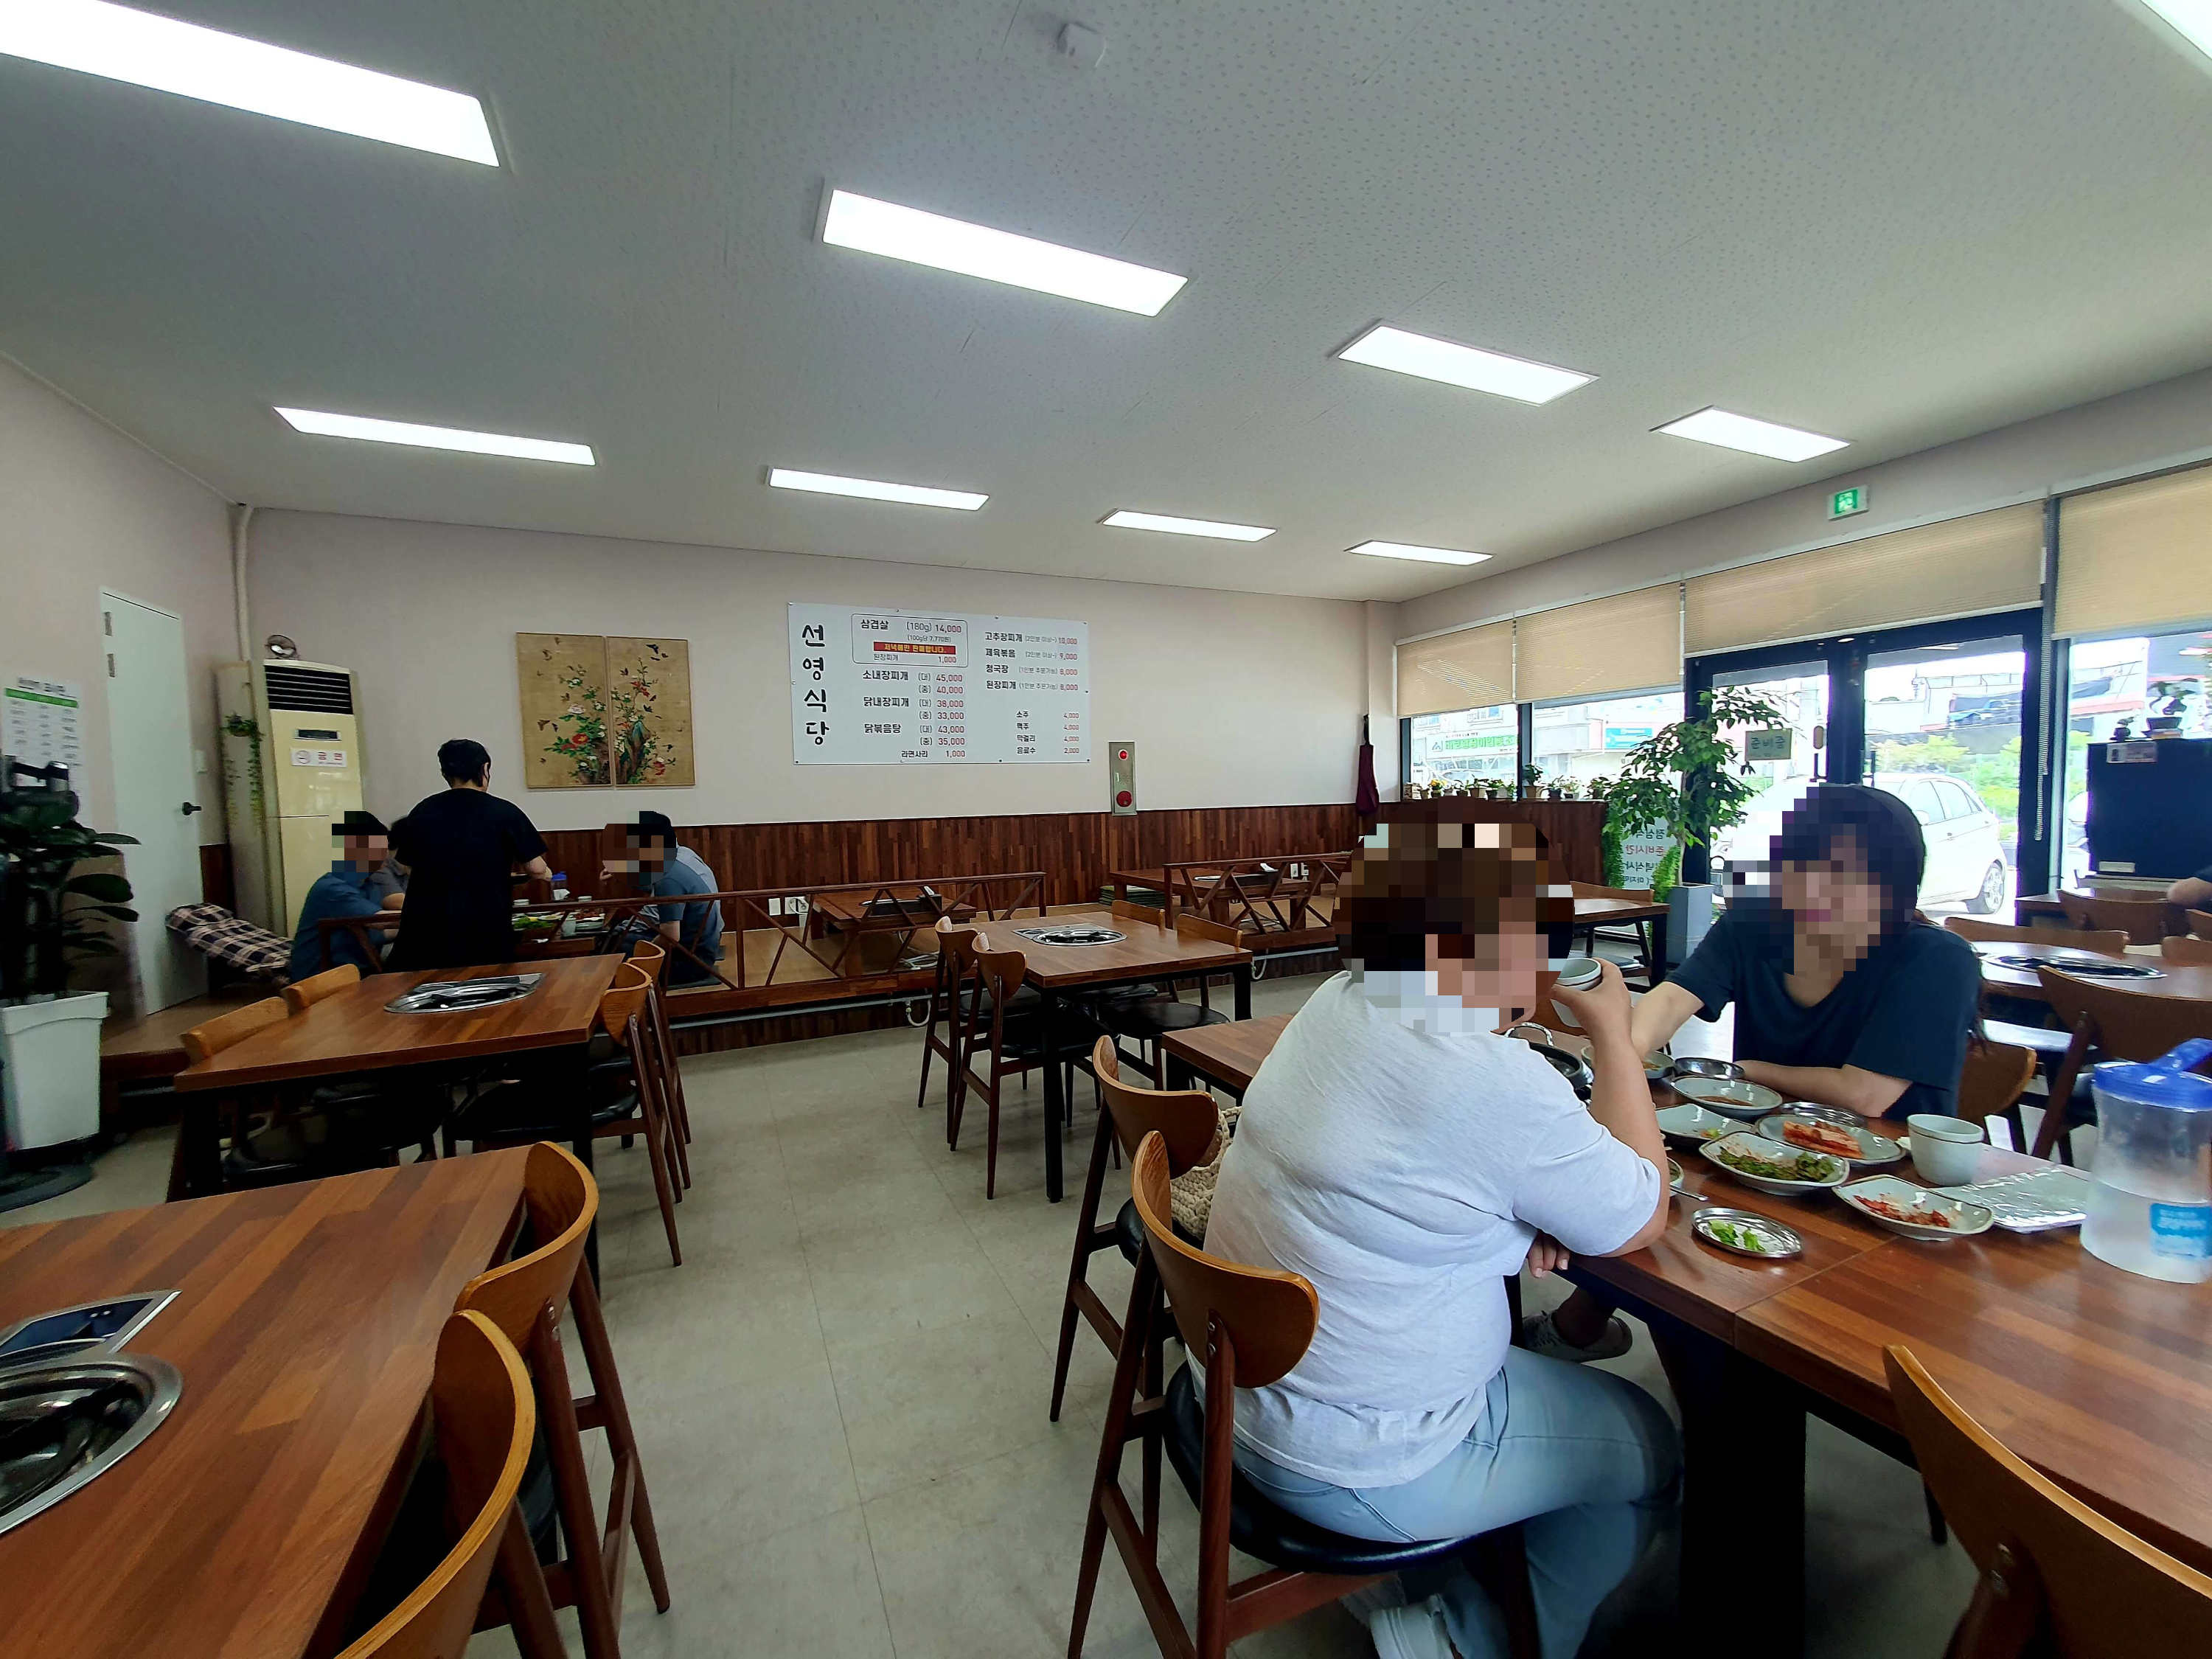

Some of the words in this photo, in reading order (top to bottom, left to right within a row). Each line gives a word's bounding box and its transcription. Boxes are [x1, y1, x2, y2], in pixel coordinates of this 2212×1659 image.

[860, 619, 888, 630] 삼겹살
[906, 622, 932, 633] (180g)
[936, 624, 962, 633] 14,000
[984, 632, 1023, 642] 고추장찌개
[1058, 637, 1078, 645] 10,000
[873, 653, 899, 661] 된장찌개
[985, 648, 1016, 658] 제육볶음
[1060, 653, 1078, 661] 9,000
[986, 664, 1009, 673] 청국장
[1060, 668, 1078, 676] 8,000
[862, 669, 908, 681] 소내장찌개
[918, 672, 931, 681] (대)
[936, 674, 963, 683] 45,000
[802, 625, 830, 745] 선영식당
[919, 684, 931, 694] (중)
[936, 686, 964, 695] 40,000
[986, 681, 1017, 690] 된장찌개
[1060, 684, 1079, 692] 8,000
[863, 697, 910, 708] 닭내장찌개
[919, 698, 932, 708] (대)
[936, 700, 964, 709] 38,000
[919, 711, 932, 720] (중)
[937, 712, 964, 720] 33,000
[864, 723, 902, 734] 닭볶음탕
[920, 724, 933, 734] (대)
[938, 726, 965, 734] 43,000
[920, 737, 933, 746] (중)
[938, 737, 965, 746] 35,000
[1017, 734, 1035, 742] 막걸리
[1750, 736, 1786, 749] 준비중
[901, 750, 928, 758] 라면사리
[945, 750, 966, 758] 1,000
[1017, 746, 1036, 754] 음료수
